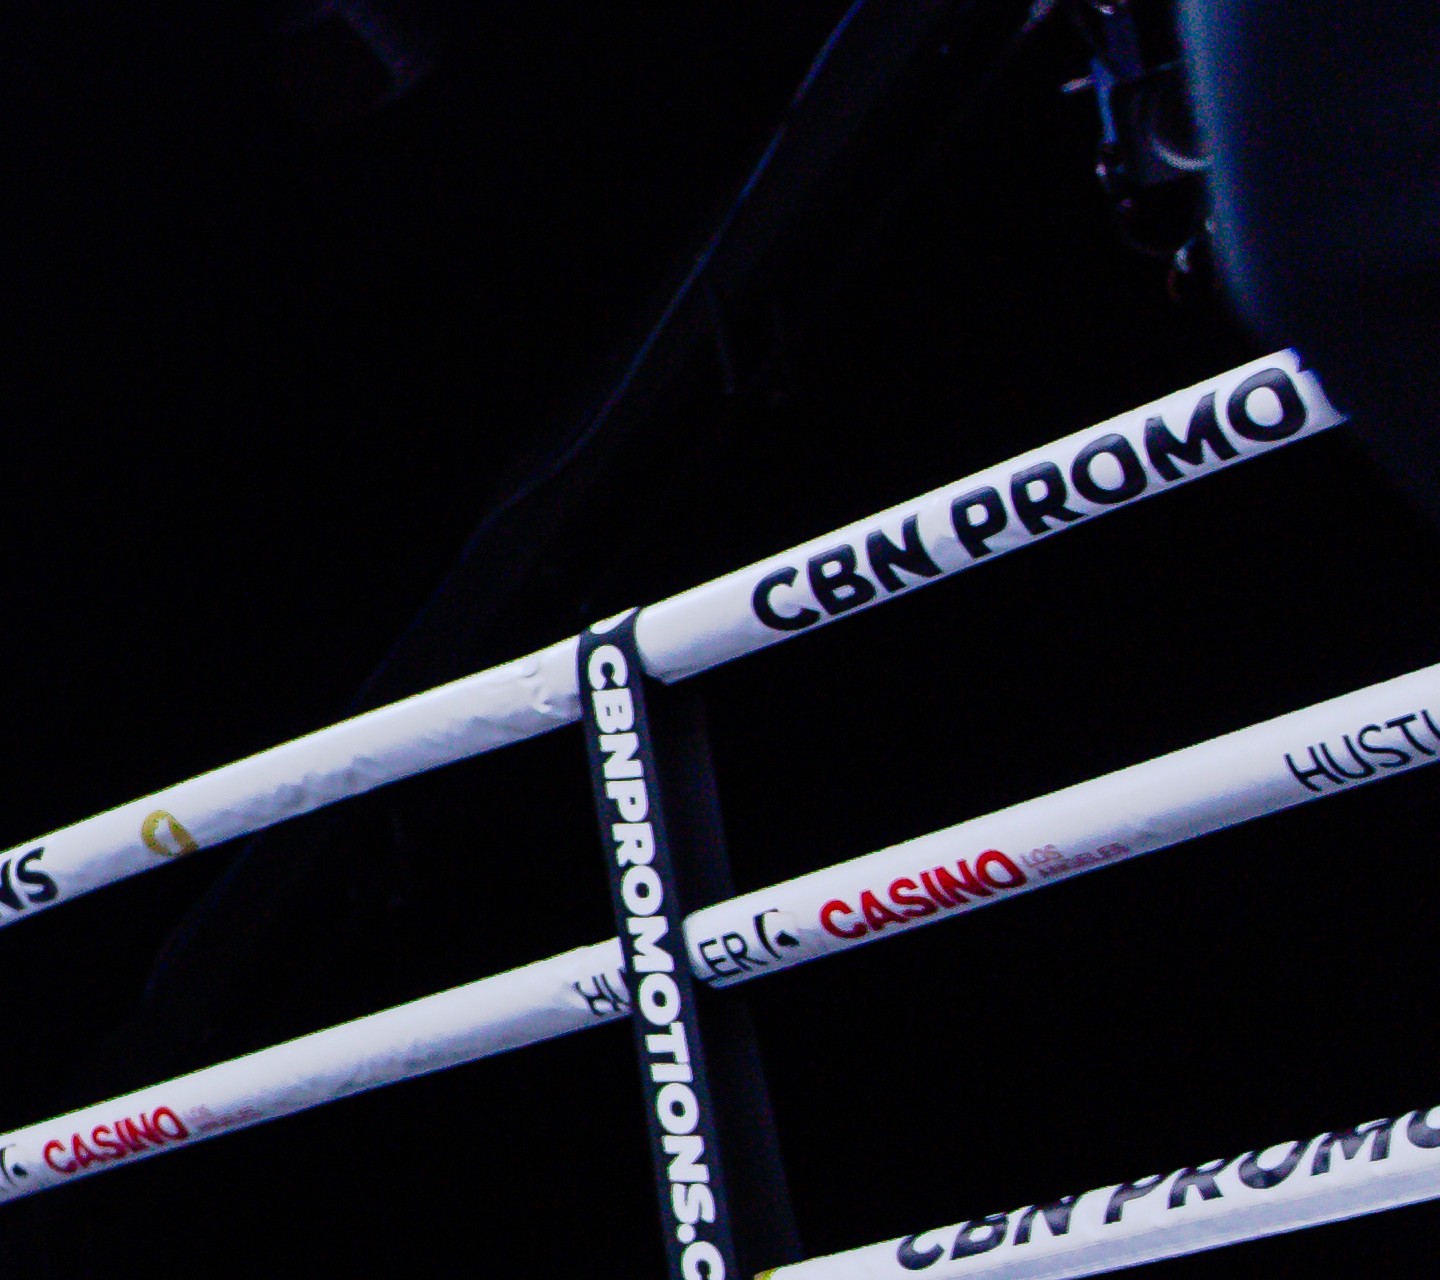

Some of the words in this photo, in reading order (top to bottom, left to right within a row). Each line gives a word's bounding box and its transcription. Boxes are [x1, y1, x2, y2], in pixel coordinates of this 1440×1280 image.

[750, 513, 942, 633] CBN
[820, 848, 1027, 940] CASINO
[42, 1105, 189, 1175] CASINO
